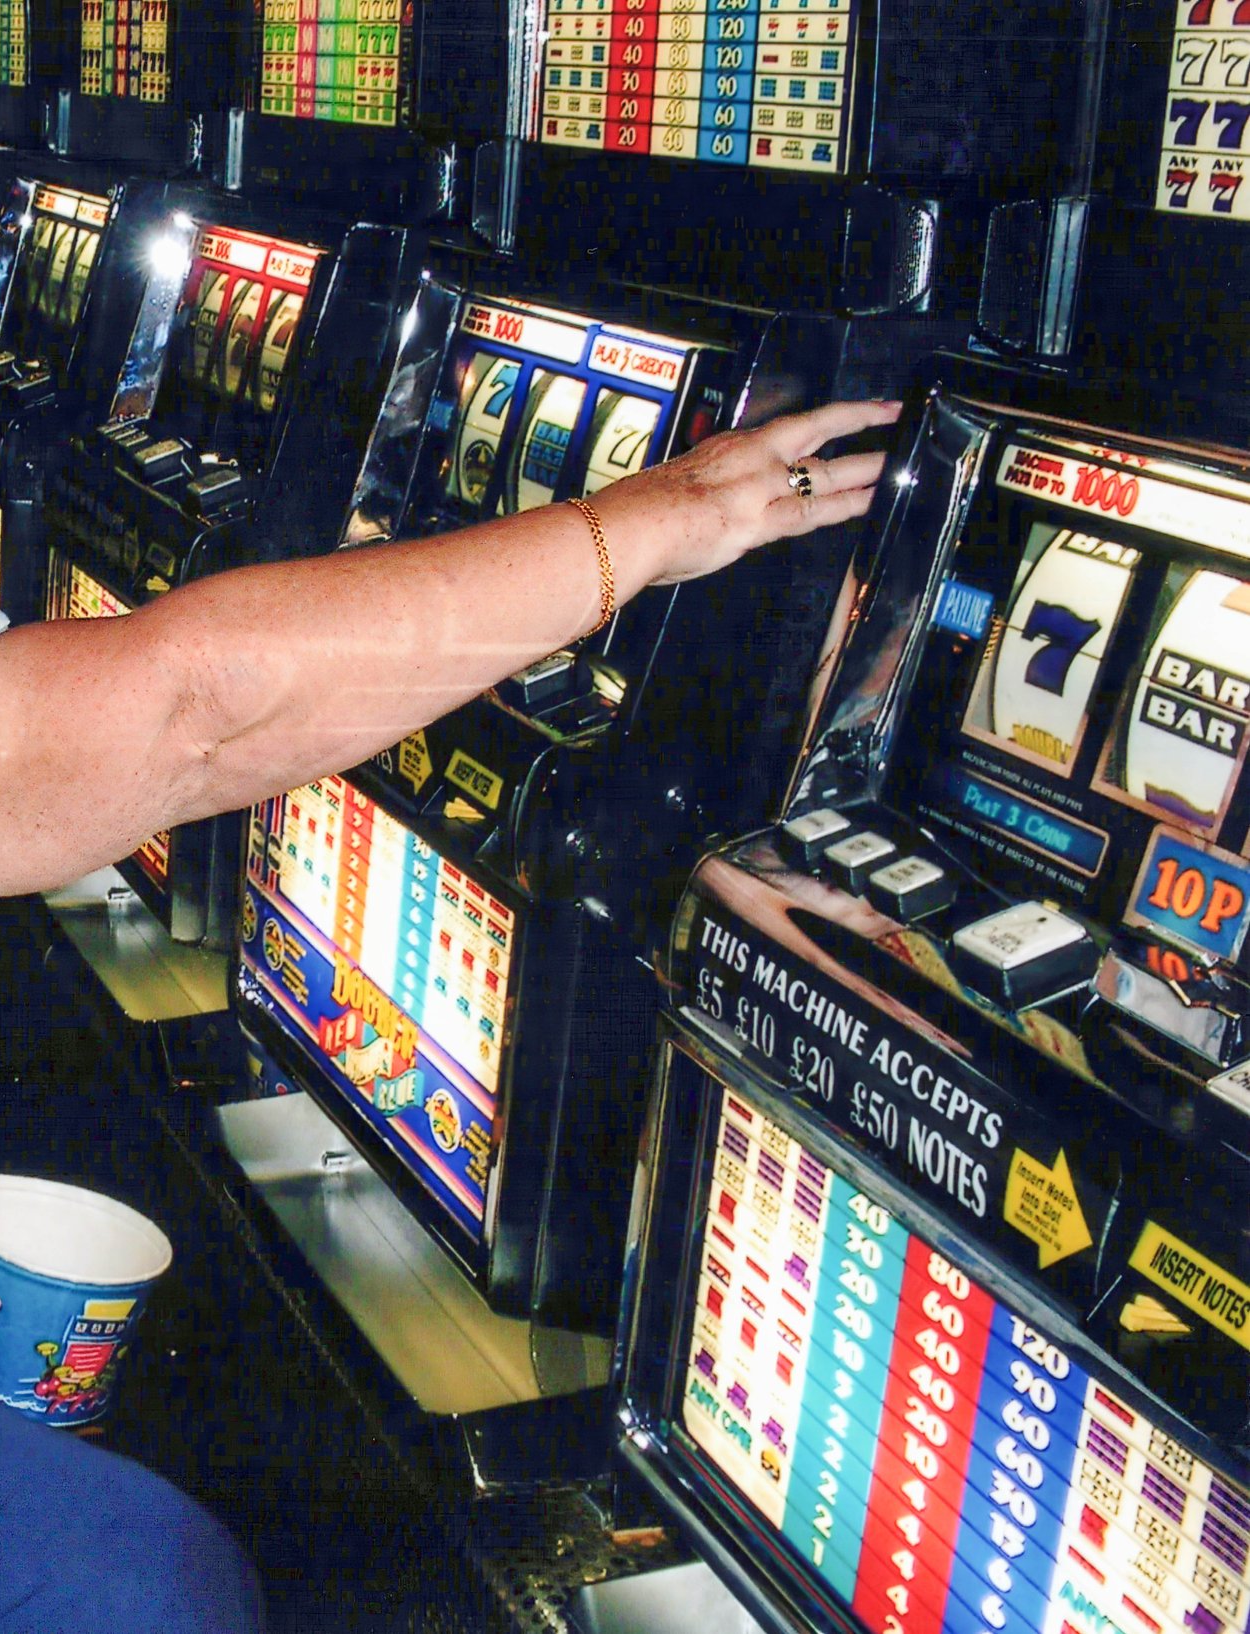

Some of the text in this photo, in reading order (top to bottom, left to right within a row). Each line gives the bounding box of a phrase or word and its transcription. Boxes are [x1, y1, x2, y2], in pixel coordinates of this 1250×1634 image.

[624, 17, 645, 37] 40
[718, 18, 745, 39] 120
[622, 44, 642, 64] 40
[716, 47, 743, 67] 120
[717, 76, 738, 97] 90
[620, 99, 638, 119] 20
[714, 105, 736, 126] 60
[618, 126, 636, 146] 20
[712, 134, 733, 155] 60
[1169, 156, 1243, 171] ANY ANY
[494, 313, 523, 343] 1000
[535, 421, 571, 446] BAR
[608, 424, 653, 469] 7
[1033, 475, 1049, 490] UP
[1050, 480, 1065, 495] TO
[1072, 466, 1139, 517] 1000
[941, 587, 991, 633] PAYLINE
[1022, 599, 1102, 698] 7
[1157, 655, 1250, 709] BAR
[1147, 694, 1233, 750] BAR
[1006, 806, 1021, 826] 3
[325, 1012, 357, 1051] RED
[701, 916, 750, 973] THIS
[752, 955, 869, 1057] MACHINE
[869, 1038, 1003, 1149] ACCEPTS
[378, 1072, 417, 1112] BLUE
[696, 968, 724, 1019] £5
[735, 996, 775, 1058] £10
[790, 1036, 835, 1101] £20
[850, 1081, 898, 1149] £50
[908, 1116, 988, 1218] NOTES
[1016, 1161, 1045, 1190] Insert
[847, 1192, 1071, 1380] 40 80 120
[1150, 1242, 1250, 1329] INSERT NOTES
[838, 1259, 879, 1306] 20
[914, 1328, 961, 1376] 40
[1002, 1399, 1051, 1451] 60
[922, 1290, 965, 1338] 60
[1010, 1360, 1057, 1413] 90
[833, 1293, 873, 1341] 20
[909, 1364, 955, 1412] 40
[996, 1436, 1044, 1490] 60
[832, 1328, 1037, 1529] 10 20 30
[827, 1403, 1013, 1594] 2 4 6
[903, 1431, 939, 1480] 10
[990, 1511, 1026, 1560] 15
[817, 1470, 915, 1581] 2 4
[822, 1436, 1007, 1630] 2 4 6
[812, 1537, 825, 1567] 1
[812, 1503, 909, 1616] 2 4
